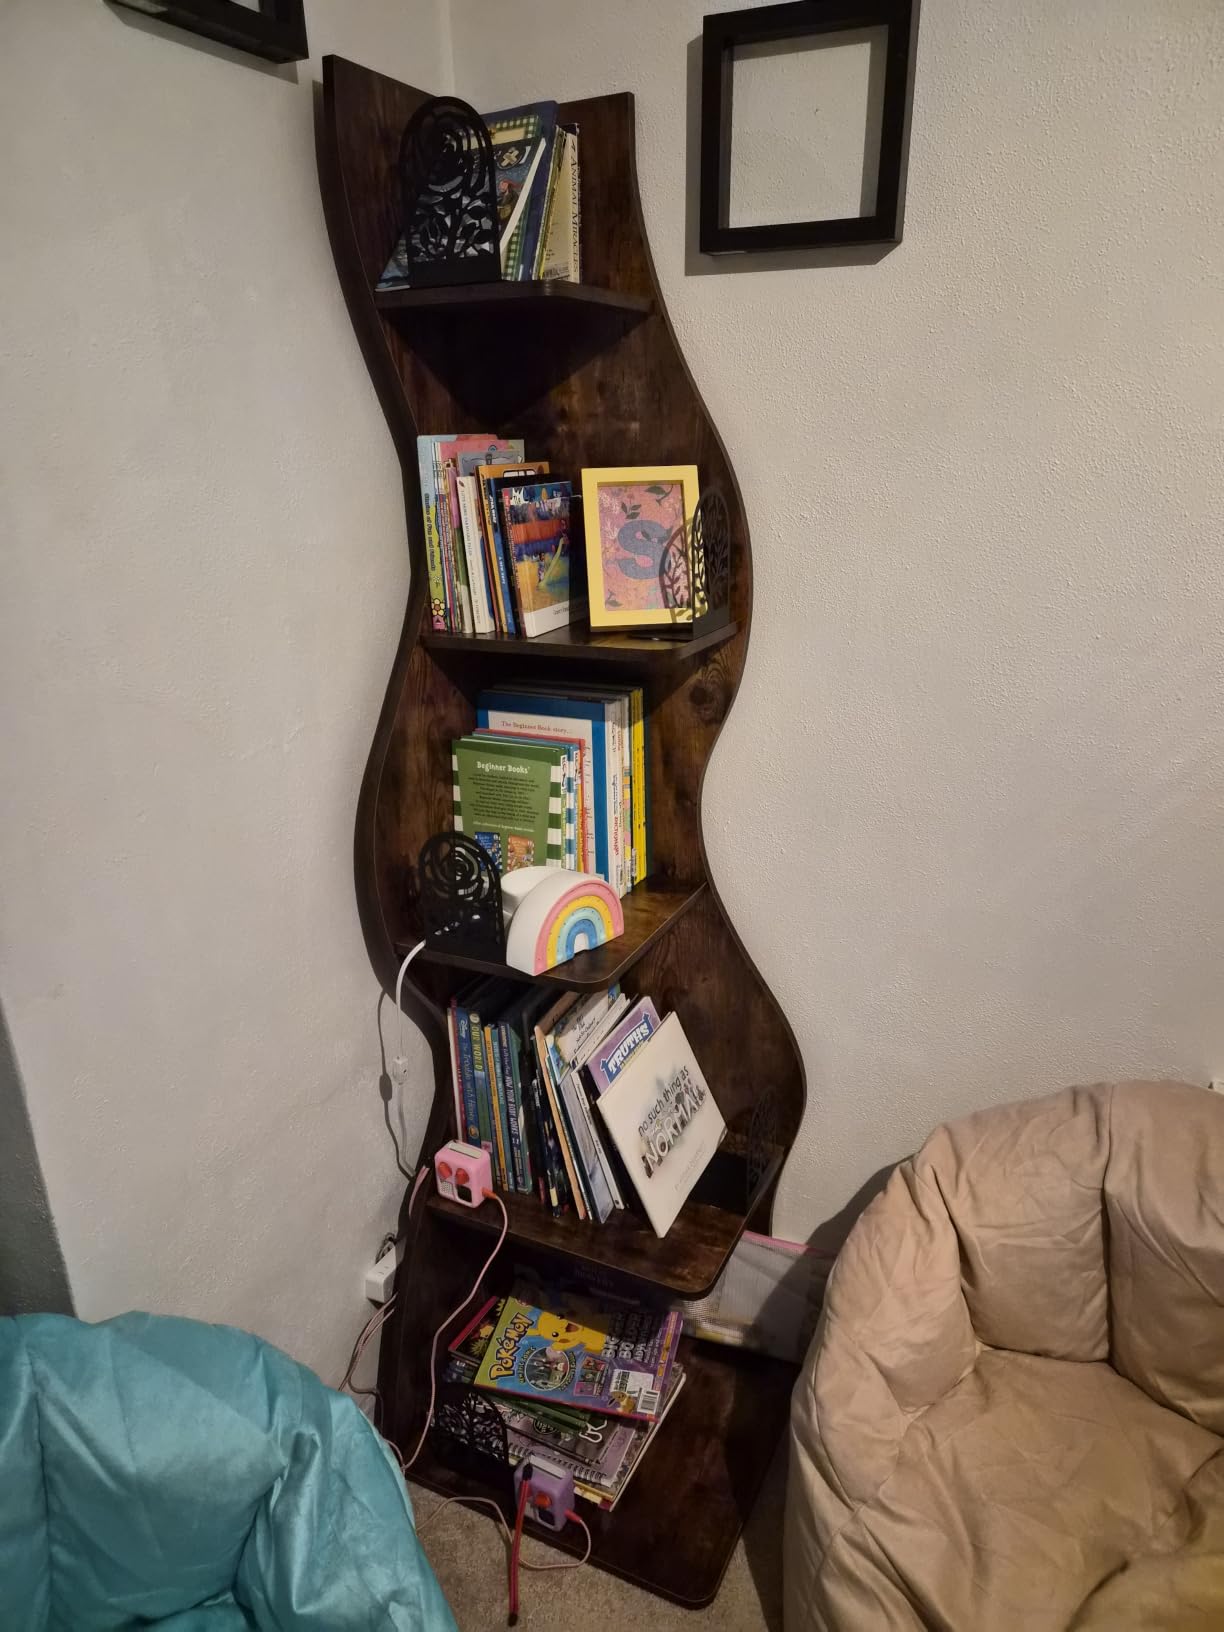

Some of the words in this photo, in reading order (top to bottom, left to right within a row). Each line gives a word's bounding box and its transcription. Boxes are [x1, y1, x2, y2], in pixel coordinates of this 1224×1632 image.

[476, 761, 506, 773] Beginner
[458, 1018, 470, 1039] Disney
[472, 1044, 484, 1071] WORLD
[607, 1023, 651, 1075] TRUTHS
[638, 1120, 649, 1136] no
[648, 1098, 664, 1126] such
[662, 1078, 683, 1106] thing
